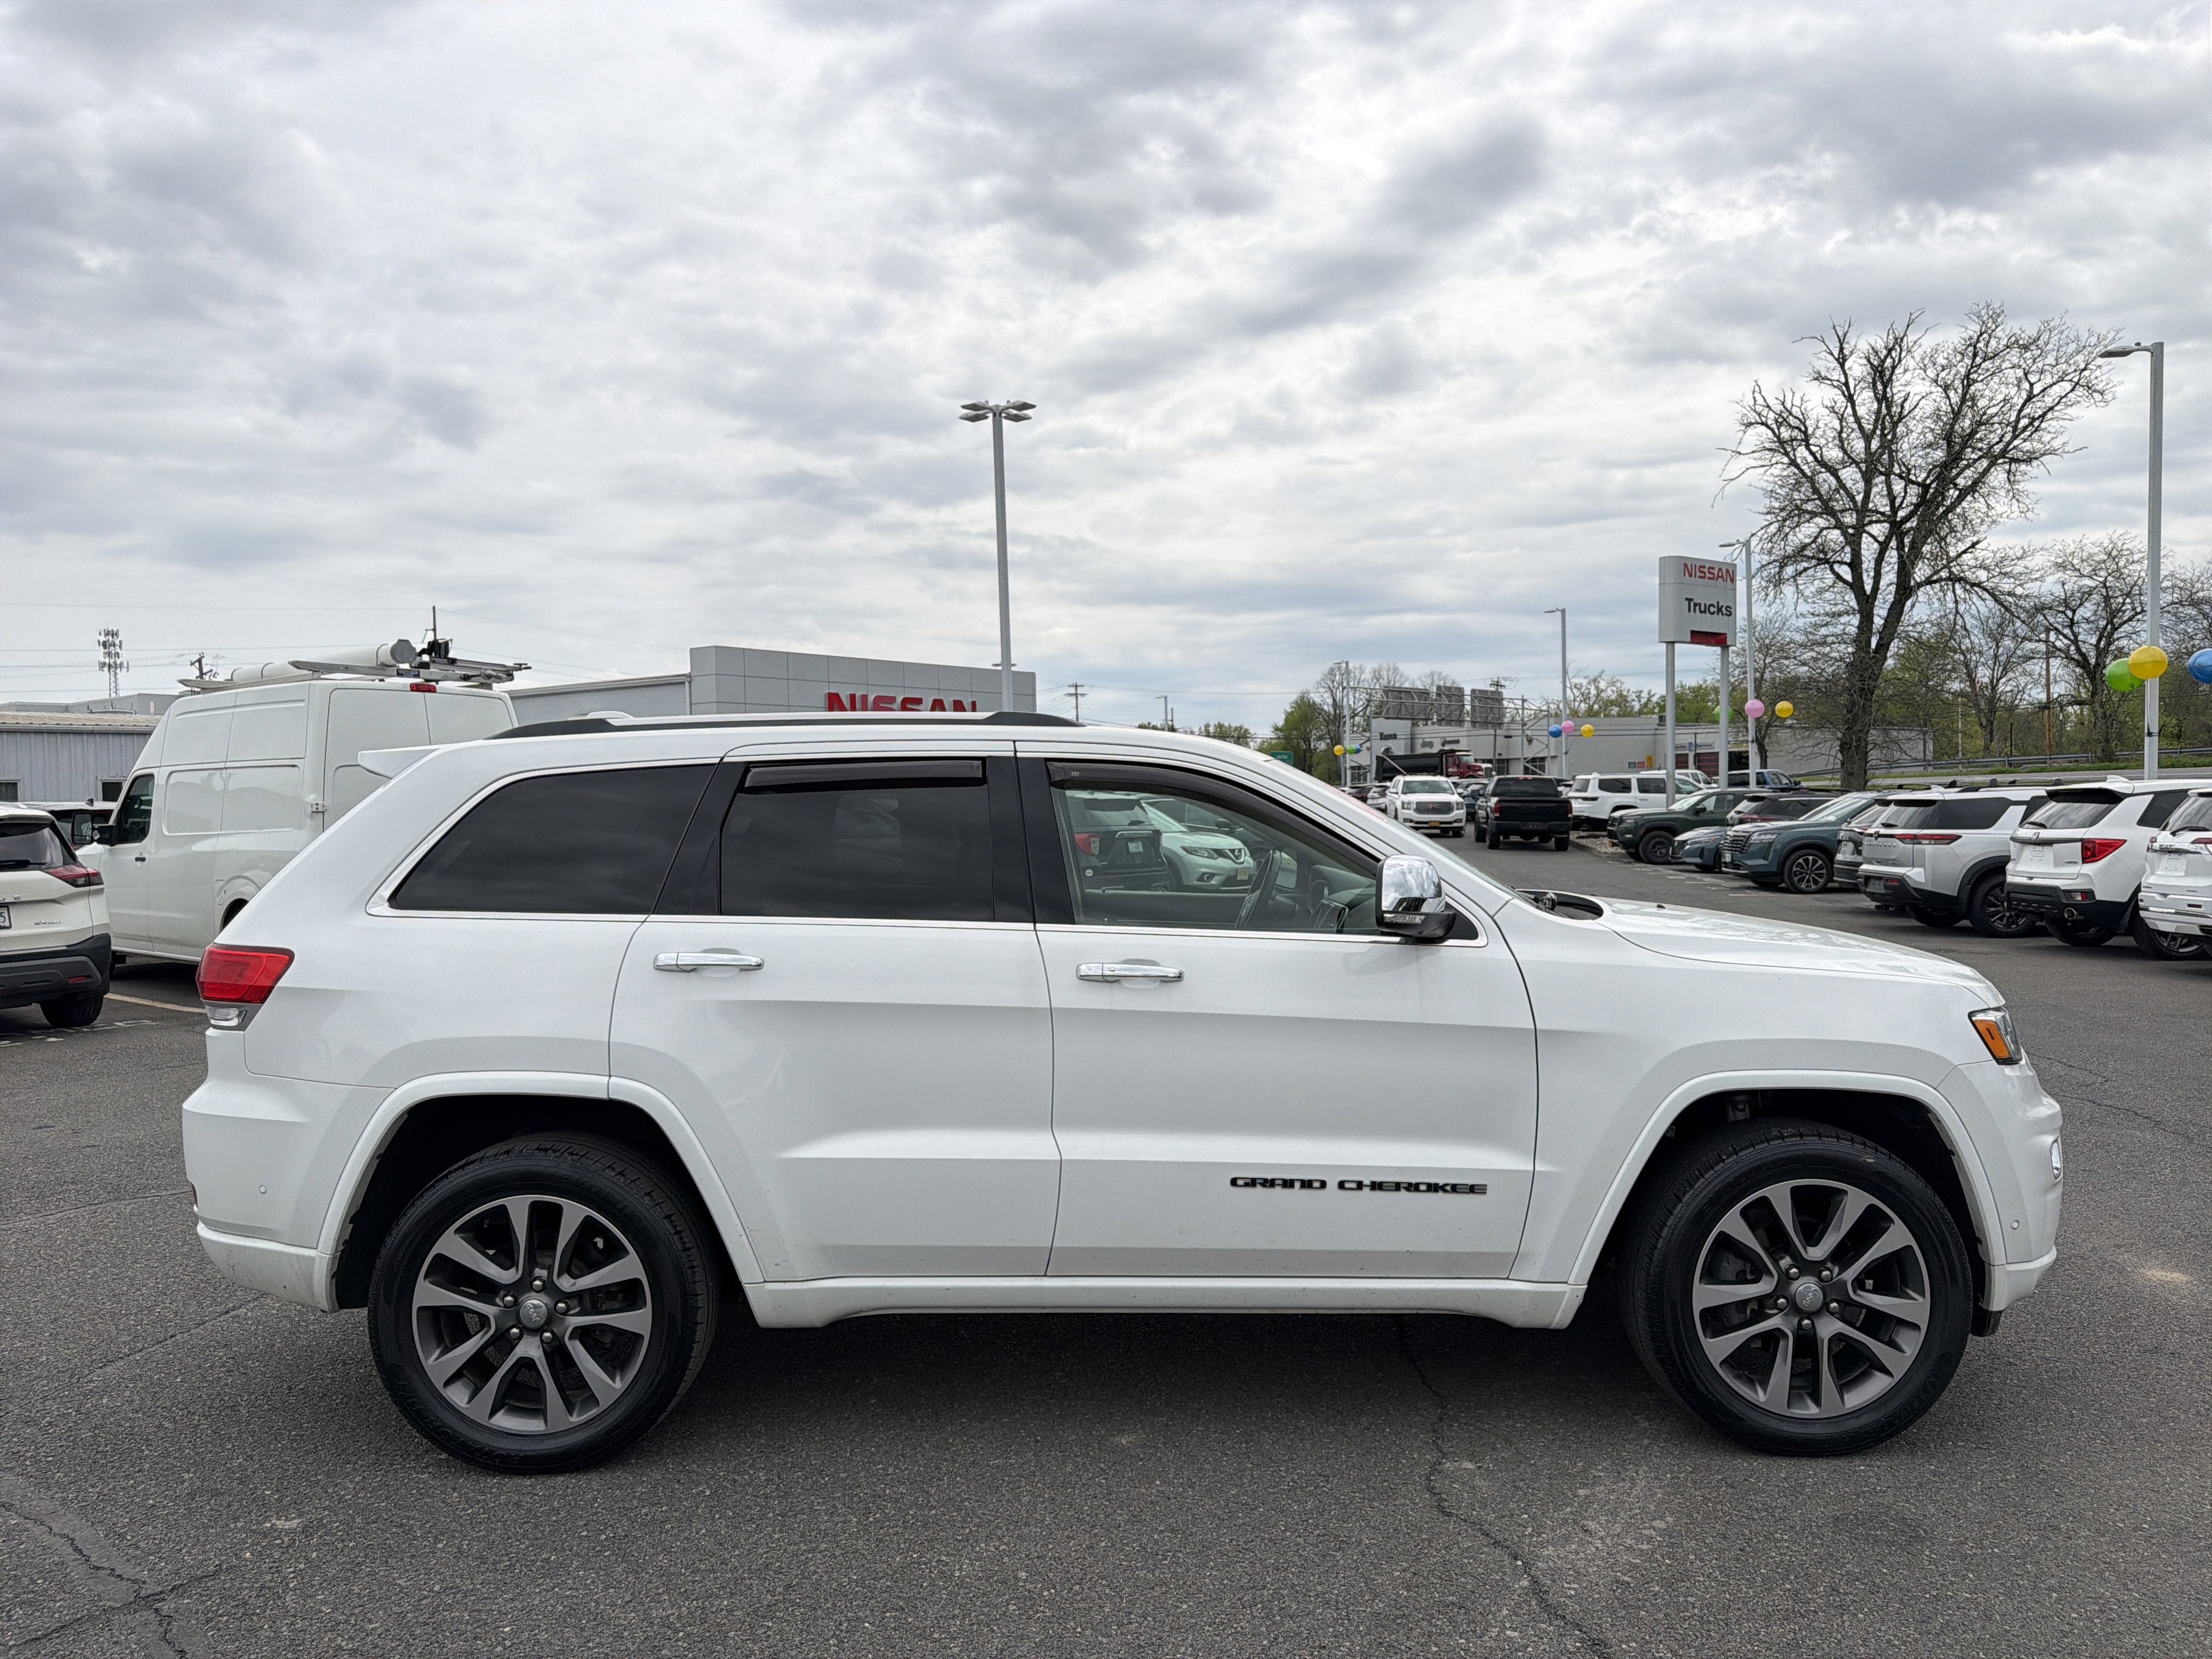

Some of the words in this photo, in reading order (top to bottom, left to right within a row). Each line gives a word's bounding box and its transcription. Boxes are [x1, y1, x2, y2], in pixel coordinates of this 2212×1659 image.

[1683, 563, 1734, 583] NISSAN
[1685, 597, 1732, 617] Trucks
[1230, 1177, 1327, 1190] GRAND
[1338, 1180, 1487, 1194] CHEROKEE
